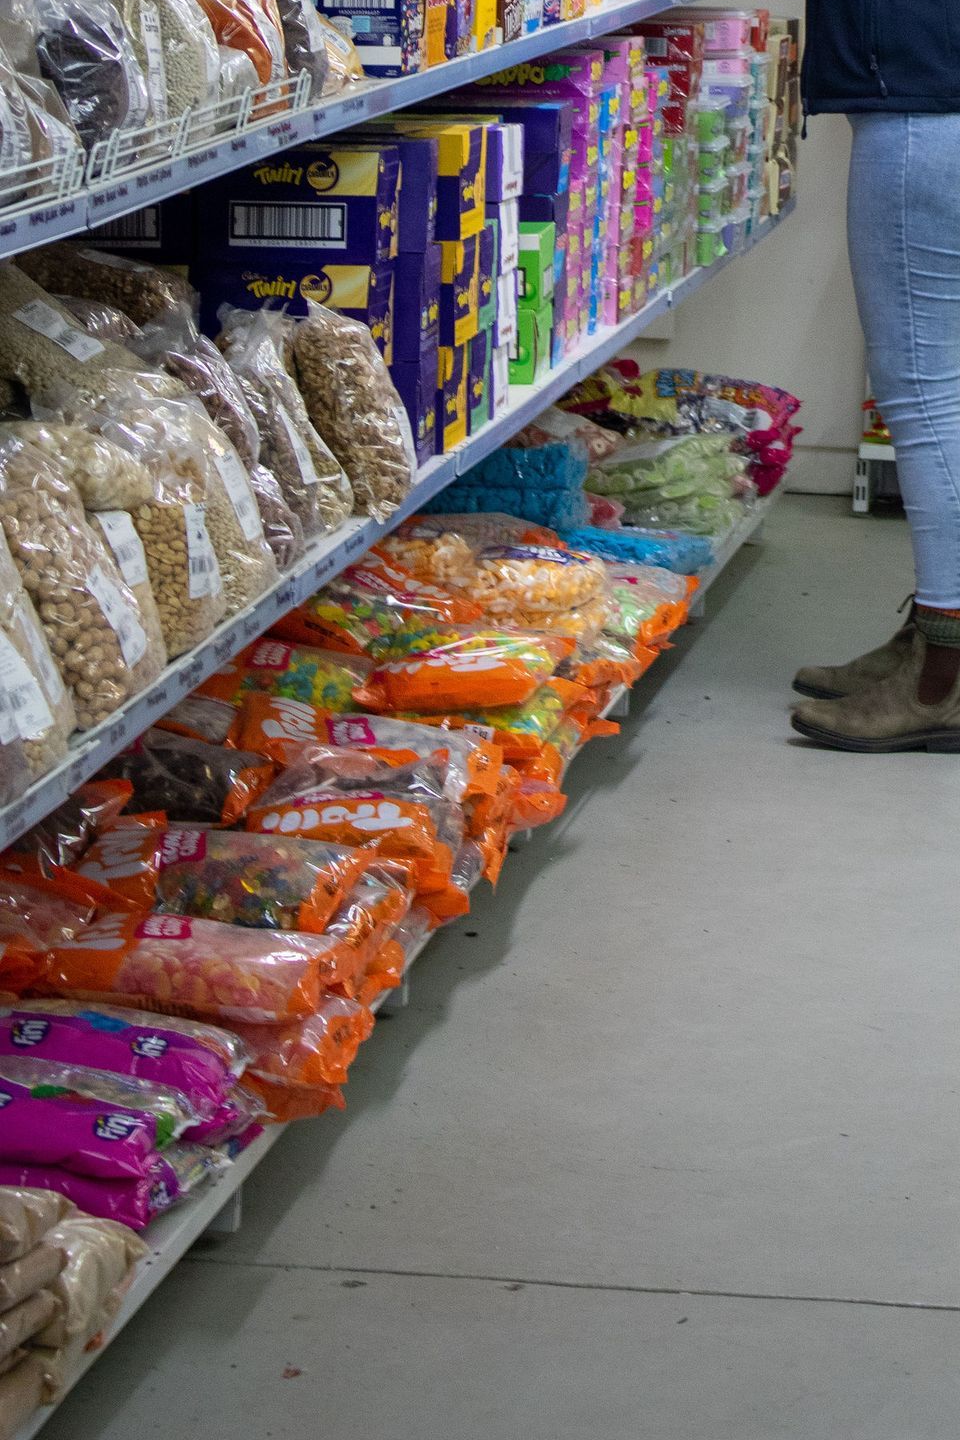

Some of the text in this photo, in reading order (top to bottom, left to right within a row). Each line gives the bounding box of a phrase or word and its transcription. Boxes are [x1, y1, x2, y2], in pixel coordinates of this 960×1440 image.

[253, 163, 303, 186] Twirl
[246, 276, 297, 299] Twirl
[13, 1020, 49, 1046] Fini
